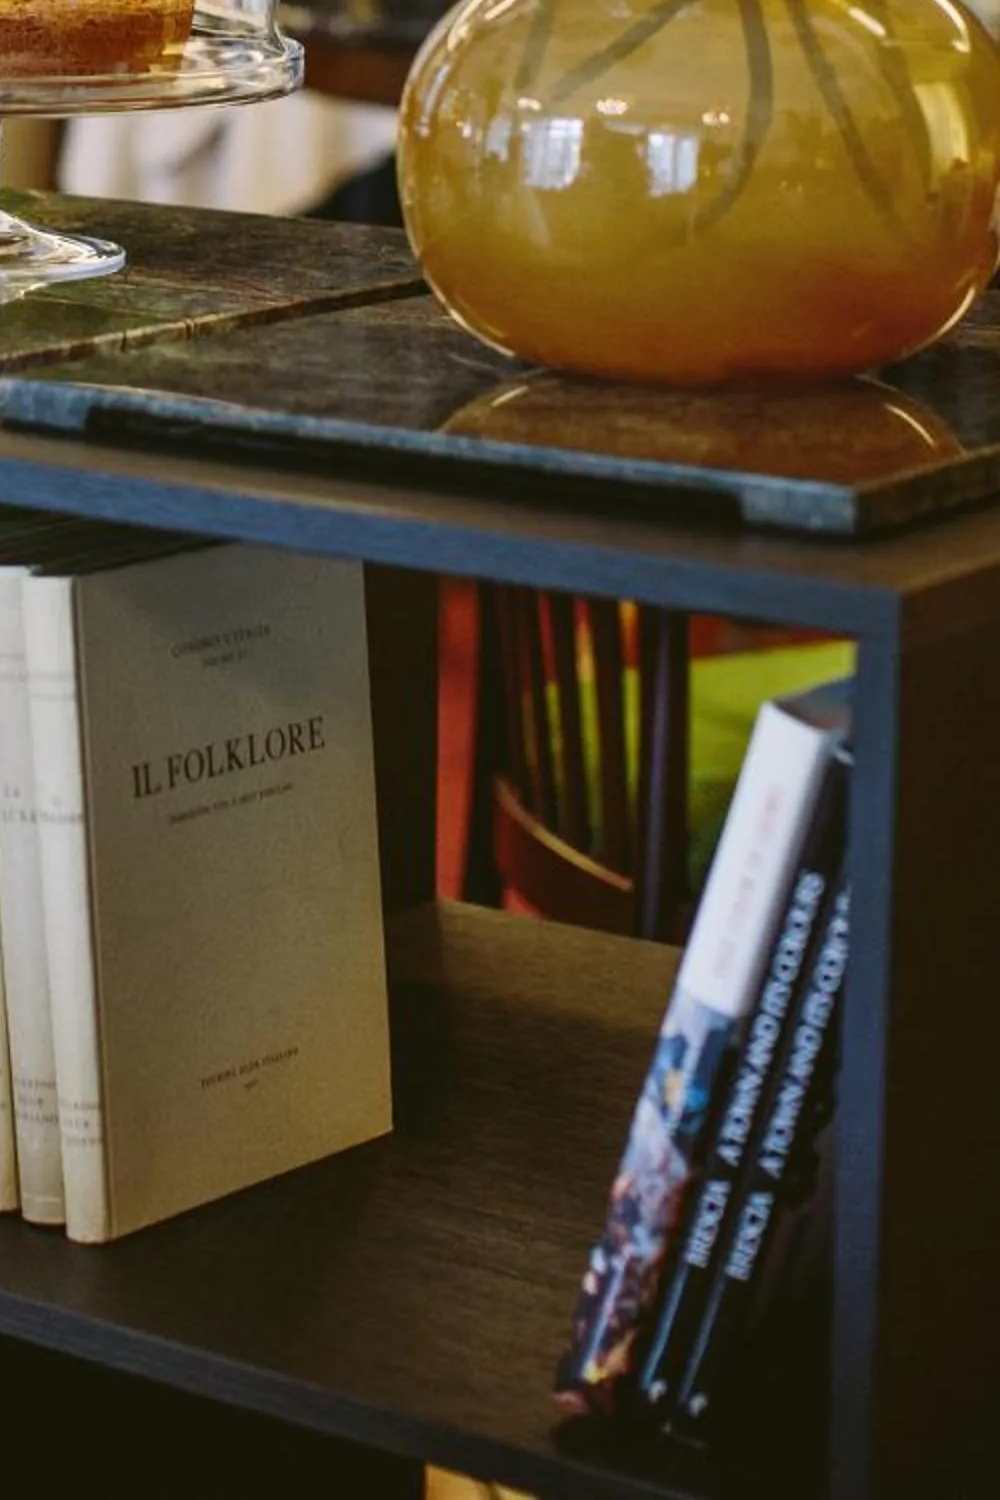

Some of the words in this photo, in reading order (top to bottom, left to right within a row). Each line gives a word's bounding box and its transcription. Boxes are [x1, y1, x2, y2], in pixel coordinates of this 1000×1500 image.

[131, 762, 162, 798] IL
[166, 716, 326, 790] FOLKLORE
[684, 1179, 732, 1269] BRESCIA
[718, 1143, 743, 1167] A
[746, 1013, 781, 1075] AND
[724, 1191, 775, 1281] BRESCIA
[758, 1154, 785, 1180] A
[787, 1024, 823, 1087] AND
